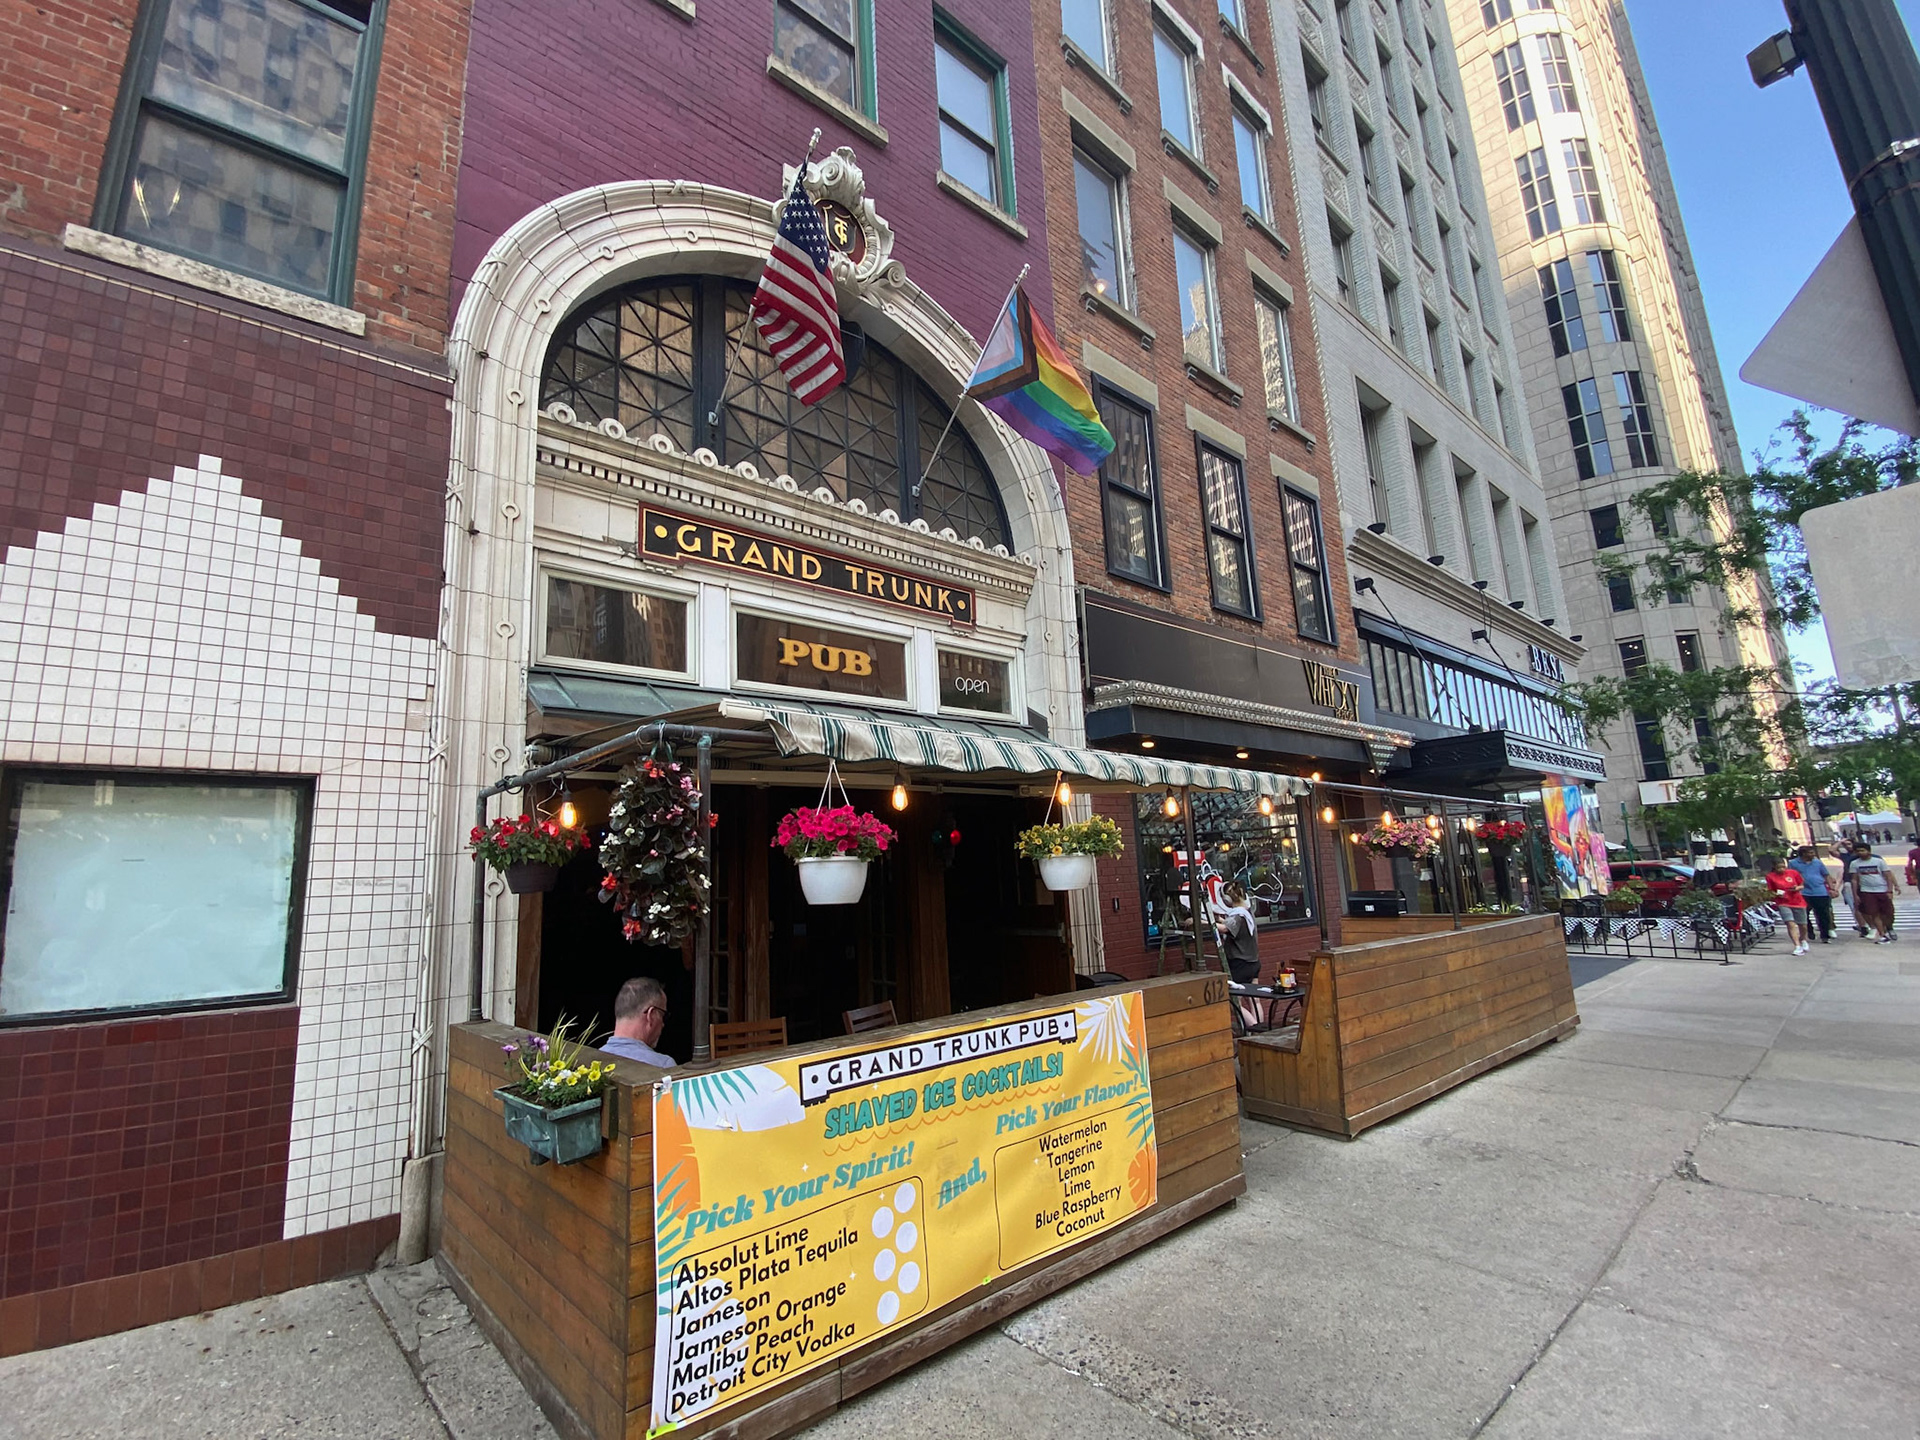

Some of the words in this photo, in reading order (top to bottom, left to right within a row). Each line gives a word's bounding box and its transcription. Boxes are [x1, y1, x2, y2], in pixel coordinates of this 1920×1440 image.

[676, 524, 823, 580] GRAND
[845, 565, 955, 613] TRUNK
[778, 637, 873, 677] PUB
[1529, 644, 1567, 684] BESA
[954, 676, 990, 695] open
[1203, 980, 1225, 1005] 612
[827, 1045, 924, 1084] GRAND
[933, 1032, 1012, 1063] TRUNK
[1018, 1018, 1060, 1046] PUB
[824, 1089, 918, 1140] SHAVED
[922, 1077, 956, 1113] ICE
[961, 1052, 1064, 1100] COCKTAILS!
[995, 1107, 1038, 1136] Pick
[1042, 1095, 1081, 1122] Your
[1083, 1074, 1139, 1107] Flavor!
[1039, 1119, 1107, 1153] Watermelon
[1047, 1140, 1103, 1168] Tangerine
[682, 1195, 756, 1241] Pick
[762, 1174, 829, 1214] Your
[833, 1141, 915, 1190] Spirit!
[937, 1156, 987, 1210] And,
[1058, 1159, 1095, 1182] Lemon
[1064, 1178, 1091, 1198] Lime
[1035, 1209, 1060, 1229] Blue
[1062, 1185, 1122, 1217] Raspberry
[1056, 1208, 1105, 1237] Coconut
[677, 1242, 759, 1288] Absolut
[765, 1227, 809, 1256] Lime
[677, 1280, 733, 1315] Altos
[739, 1259, 790, 1290] Plata
[795, 1227, 859, 1266] Tequila
[673, 1316, 770, 1365] Jameson
[776, 1282, 847, 1321] Orange
[675, 1291, 771, 1340] Jameson
[671, 1371, 745, 1414] Detroit
[752, 1351, 791, 1378] City
[797, 1321, 856, 1359] Vodka
[672, 1343, 749, 1390] Malibu
[756, 1315, 814, 1355] Peach
